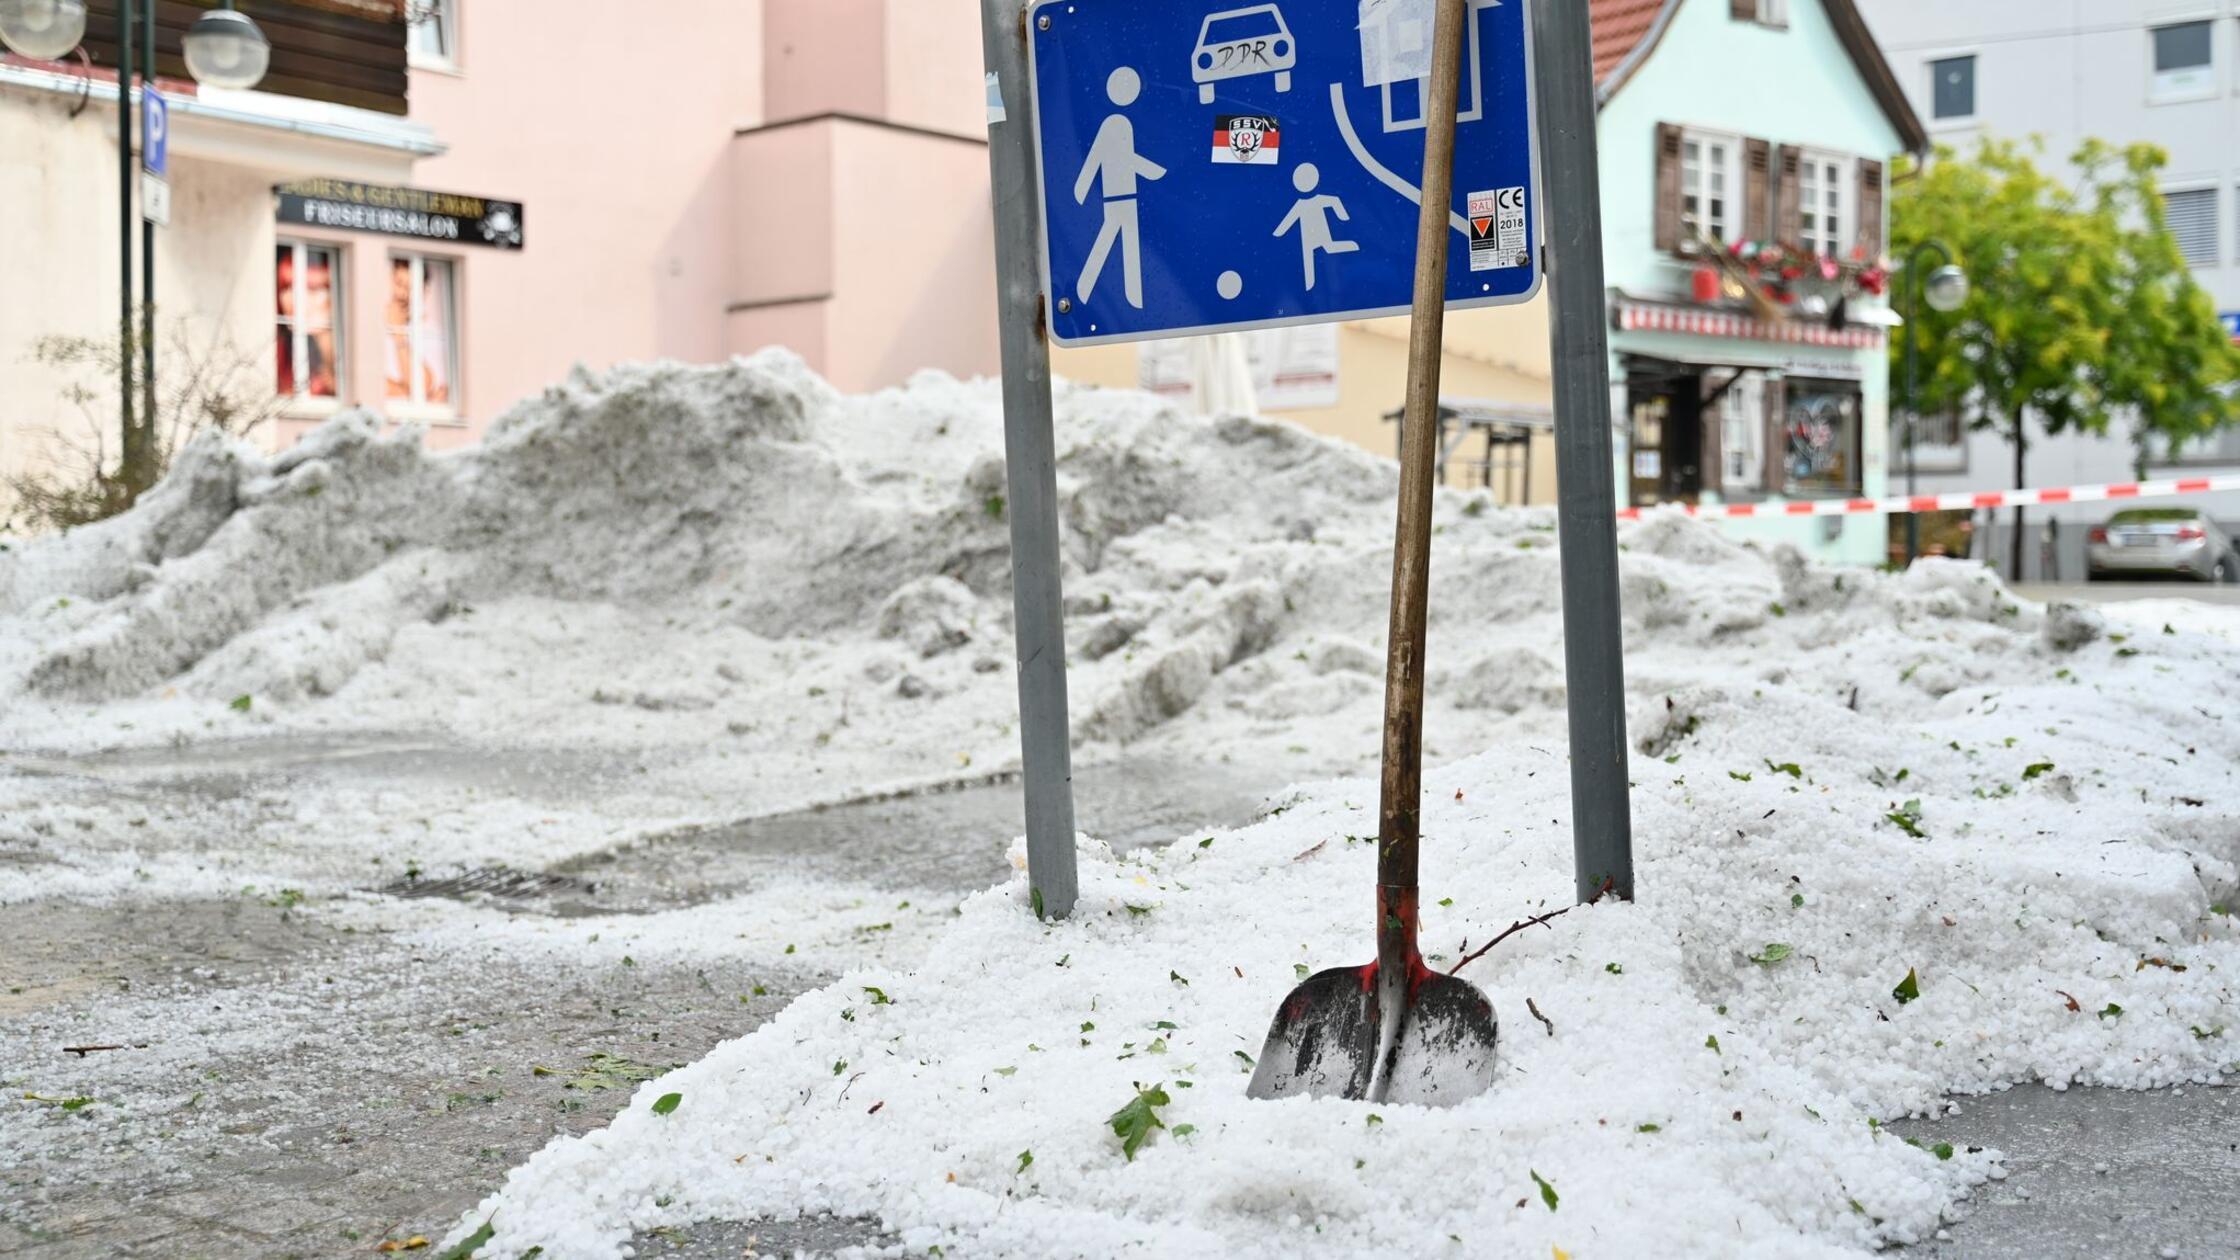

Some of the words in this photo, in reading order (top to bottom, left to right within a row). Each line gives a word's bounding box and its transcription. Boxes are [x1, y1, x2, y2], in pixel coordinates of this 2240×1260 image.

[1212, 41, 1271, 70] DDR
[149, 97, 164, 162] P
[1233, 119, 1261, 130] SSV
[1241, 133, 1251, 146] R
[1471, 201, 1491, 212] RAL
[1499, 188, 1523, 209] CE
[304, 199, 459, 240] FRISEURSALON
[1500, 218, 1524, 230] 2018
